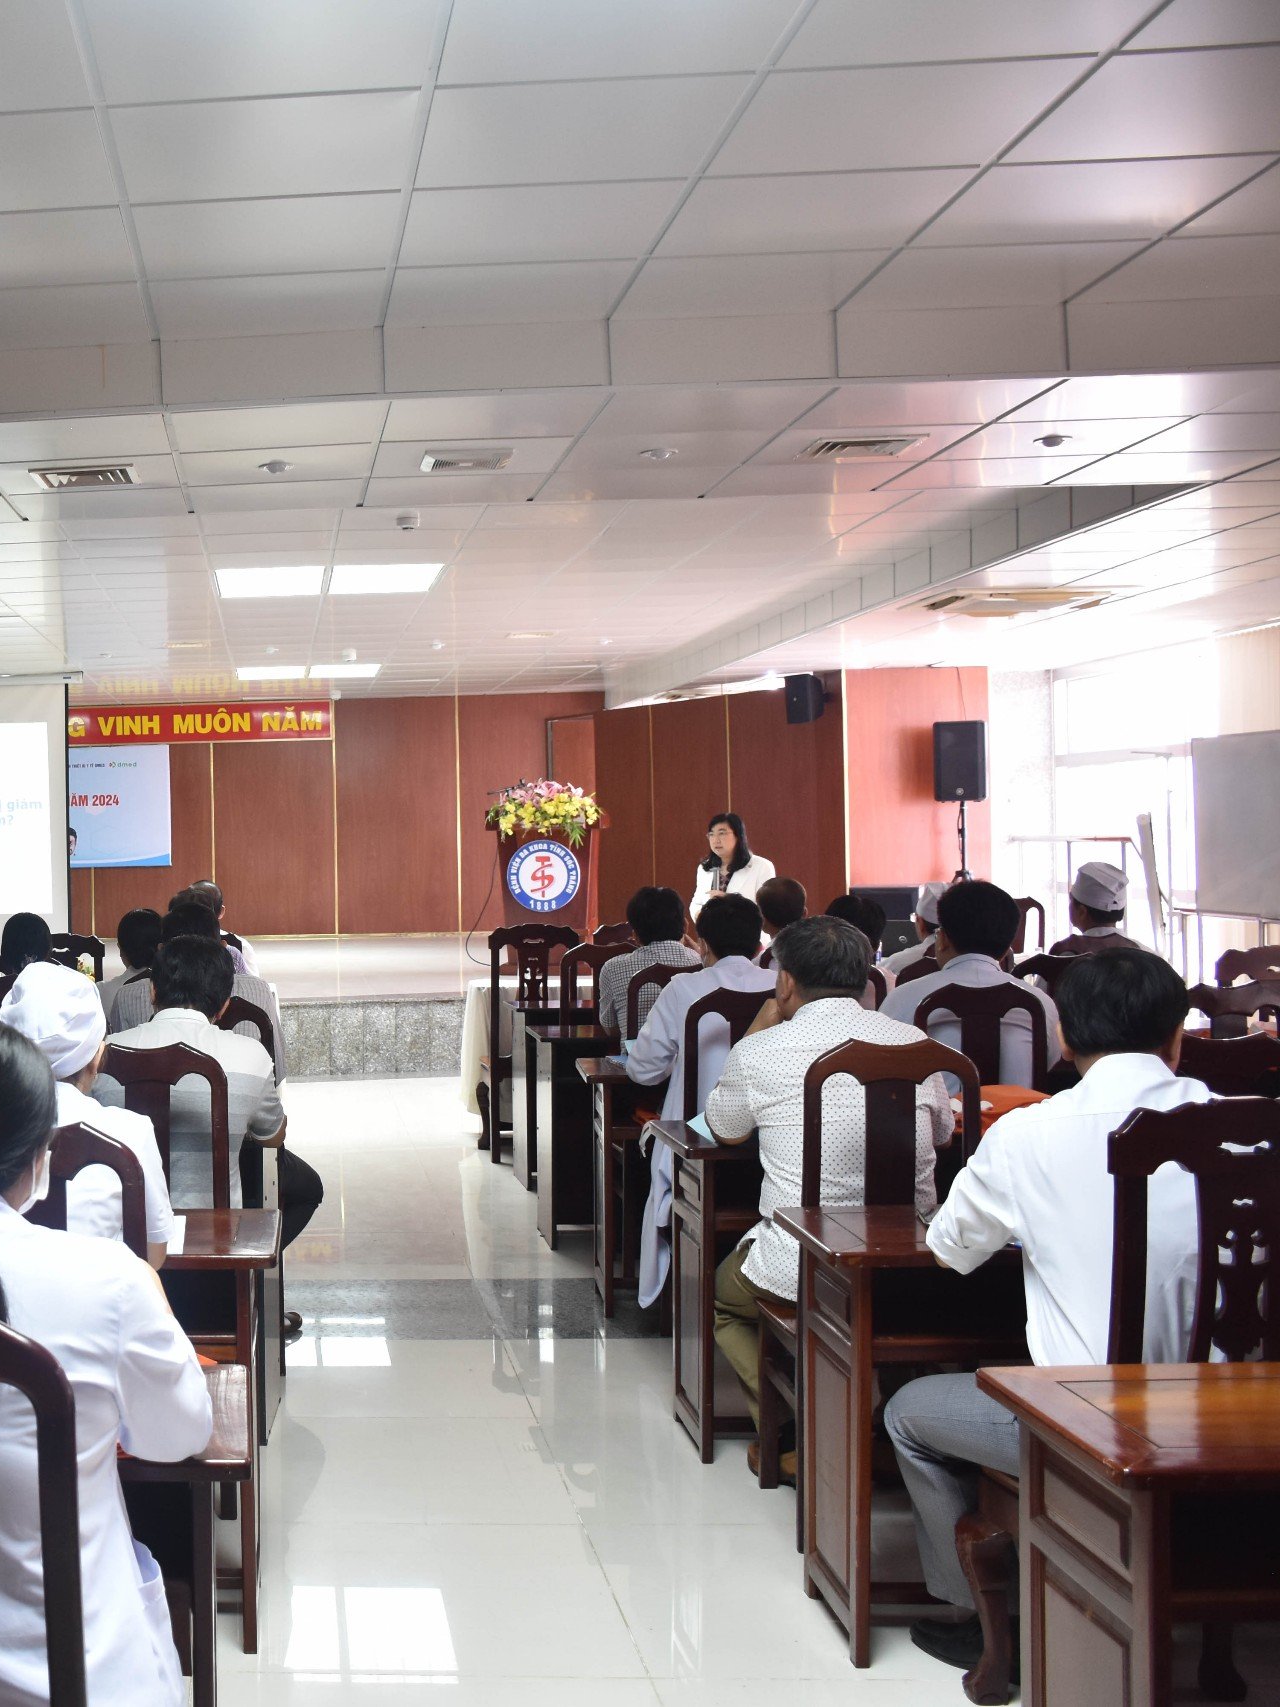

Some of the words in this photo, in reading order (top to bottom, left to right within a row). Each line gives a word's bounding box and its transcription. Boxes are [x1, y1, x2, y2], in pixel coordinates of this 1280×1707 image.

[98, 714, 160, 736] VINH
[173, 708, 251, 734] MUÔN
[261, 706, 322, 731] NĂM
[69, 792, 89, 807] ĂM
[92, 794, 120, 807] 2024
[529, 899, 557, 910] 1888
